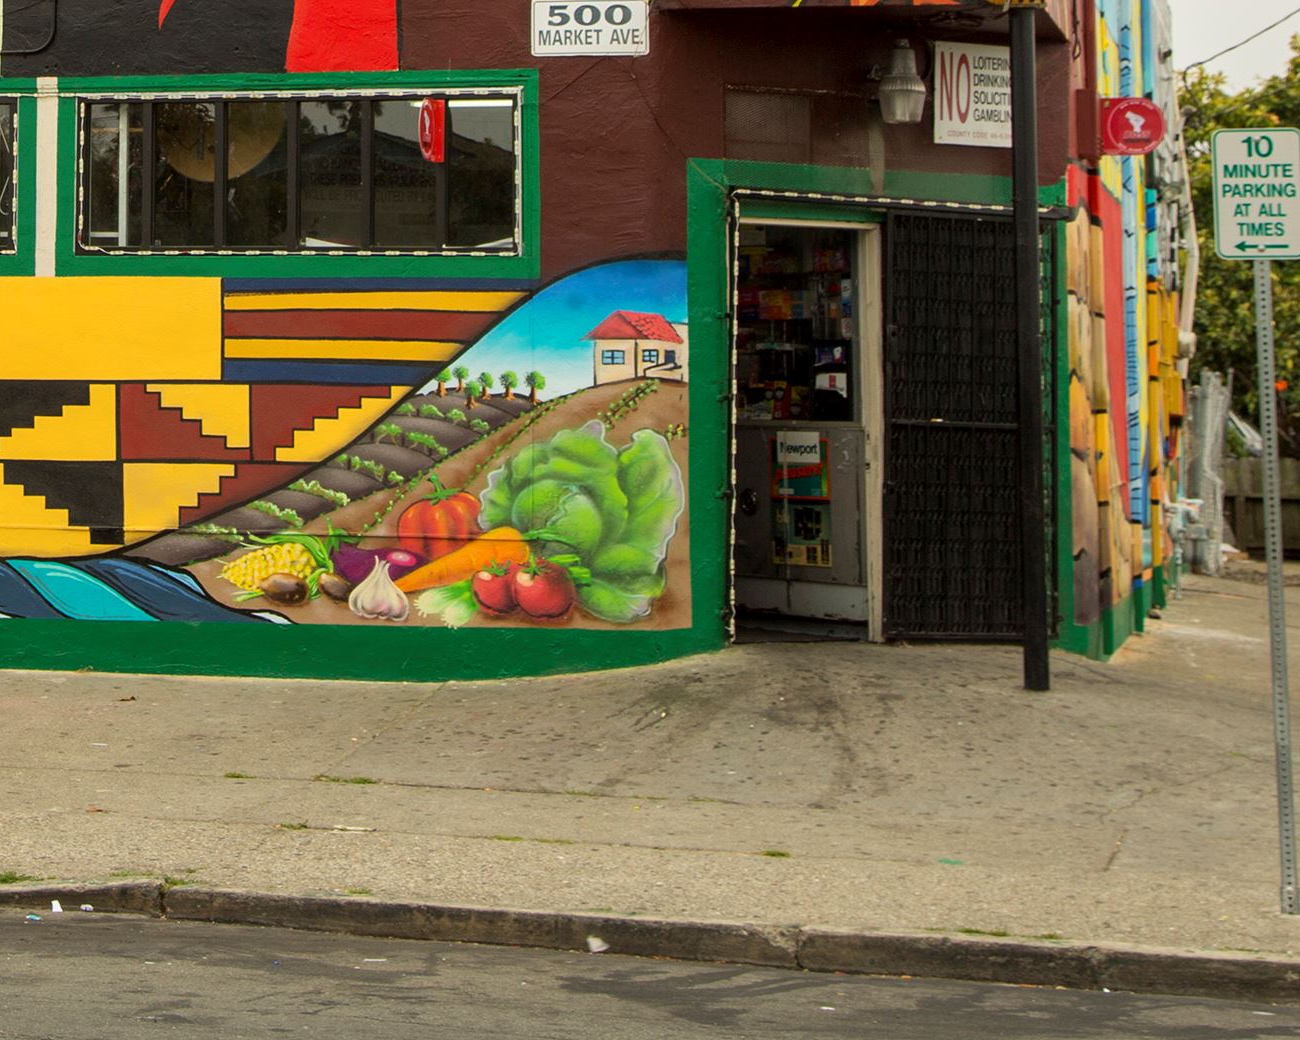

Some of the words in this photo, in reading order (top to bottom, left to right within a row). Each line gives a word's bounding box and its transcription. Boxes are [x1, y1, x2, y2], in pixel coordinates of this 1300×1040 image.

[547, 4, 632, 26] 500
[538, 29, 603, 46] MARKET
[609, 28, 644, 45] AVE.
[972, 56, 1011, 71] LOITERIN
[939, 50, 971, 124] NO
[972, 73, 1011, 87] DRINKIN
[973, 108, 1011, 123] GAMBLIN
[1241, 135, 1274, 158] 10
[1223, 164, 1293, 178] MINUTE
[1222, 183, 1296, 198] PARKING
[1233, 203, 1252, 217] AT
[1258, 203, 1287, 217] ALL
[1237, 222, 1285, 237] TIMES
[780, 441, 818, 456] Newport
